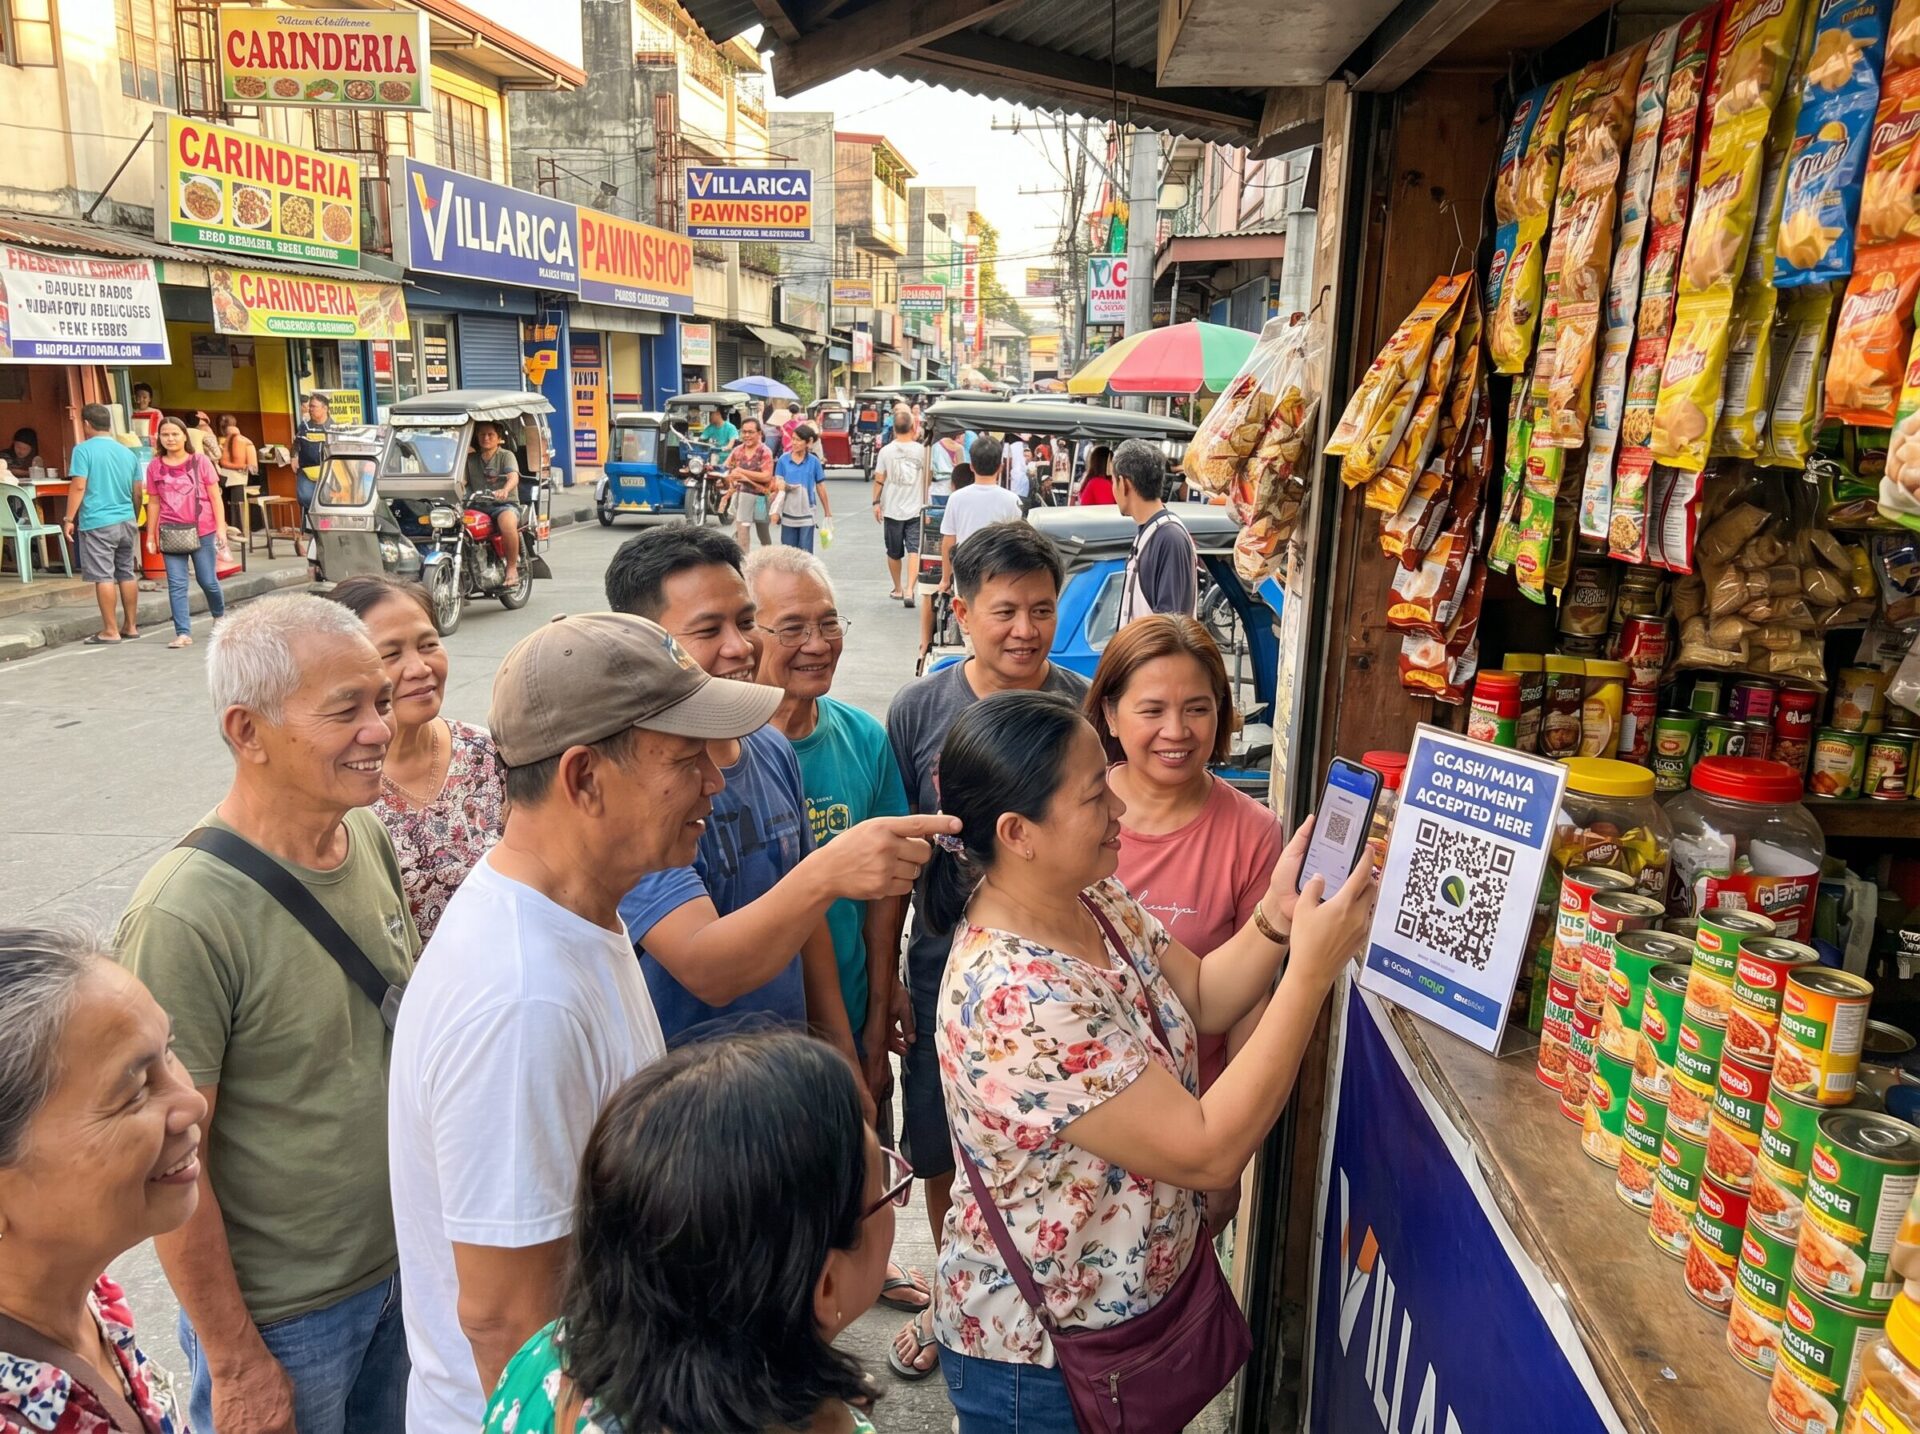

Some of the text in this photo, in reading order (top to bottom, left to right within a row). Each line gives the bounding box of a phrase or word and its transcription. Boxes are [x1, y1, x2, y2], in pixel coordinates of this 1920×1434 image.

[226, 29, 416, 74] CARINDERIA
[179, 126, 353, 200] CARINDERIA
[689, 172, 807, 197] VILLARICA
[411, 172, 575, 267] VILLARICA
[691, 203, 807, 223] PAWNSHOP
[581, 218, 691, 287] PAWNSHOP
[239, 273, 358, 317] CARINDERIA
[1431, 771, 1528, 813] QR PAYMENT
[1433, 751, 1535, 794] GCASH/MAYA
[1415, 787, 1533, 838] ACCEPTED HERE
[1418, 975, 1445, 995] maya
